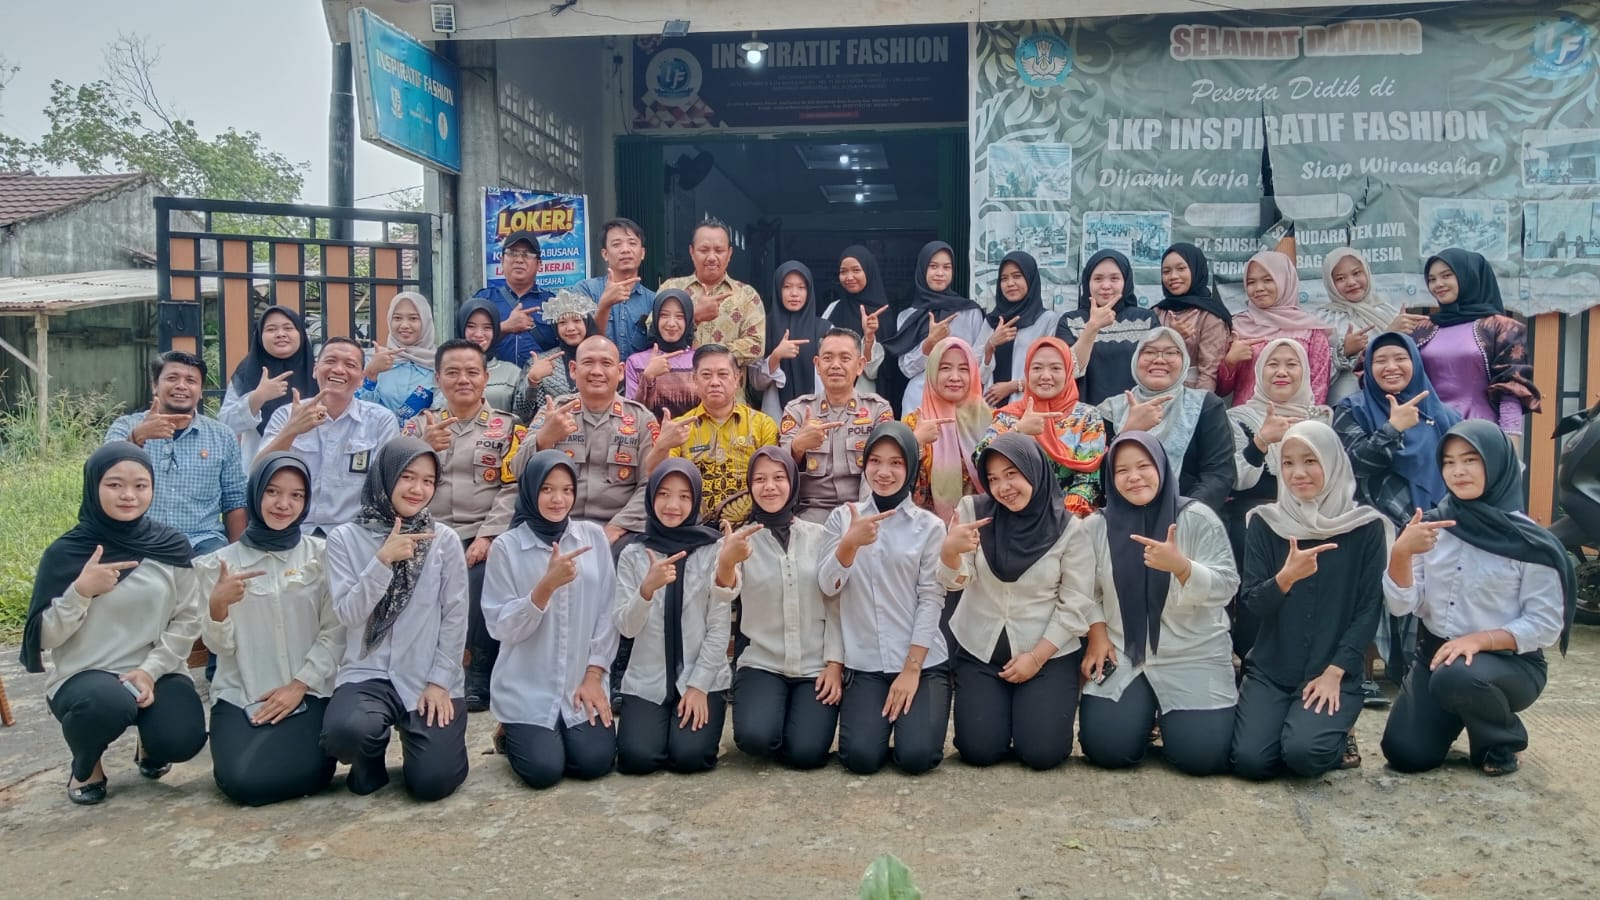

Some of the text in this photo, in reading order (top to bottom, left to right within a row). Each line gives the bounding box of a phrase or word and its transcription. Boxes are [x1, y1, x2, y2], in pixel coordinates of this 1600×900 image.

[711, 35, 949, 69] INSIRATIF FASHION
[1173, 20, 1420, 58] SELAMAT DATANG
[375, 48, 421, 89] INSPIRATIF
[423, 74, 454, 107] FASHION
[1191, 74, 1396, 105] Peserta Didik di
[1107, 110, 1489, 151] LKP INSPIRATIF FASHION
[1099, 167, 1184, 189] Dijamin
[1190, 168, 1249, 191] Kerja
[1301, 155, 1499, 181] Siap Wirausaha !
[498, 208, 574, 235] LOKER!
[1376, 221, 1407, 238] JAYA
[546, 247, 580, 258] BUSANA
[544, 261, 575, 272] KERJA!
[614, 435, 637, 445] POLRI
[851, 426, 873, 436] POLR
